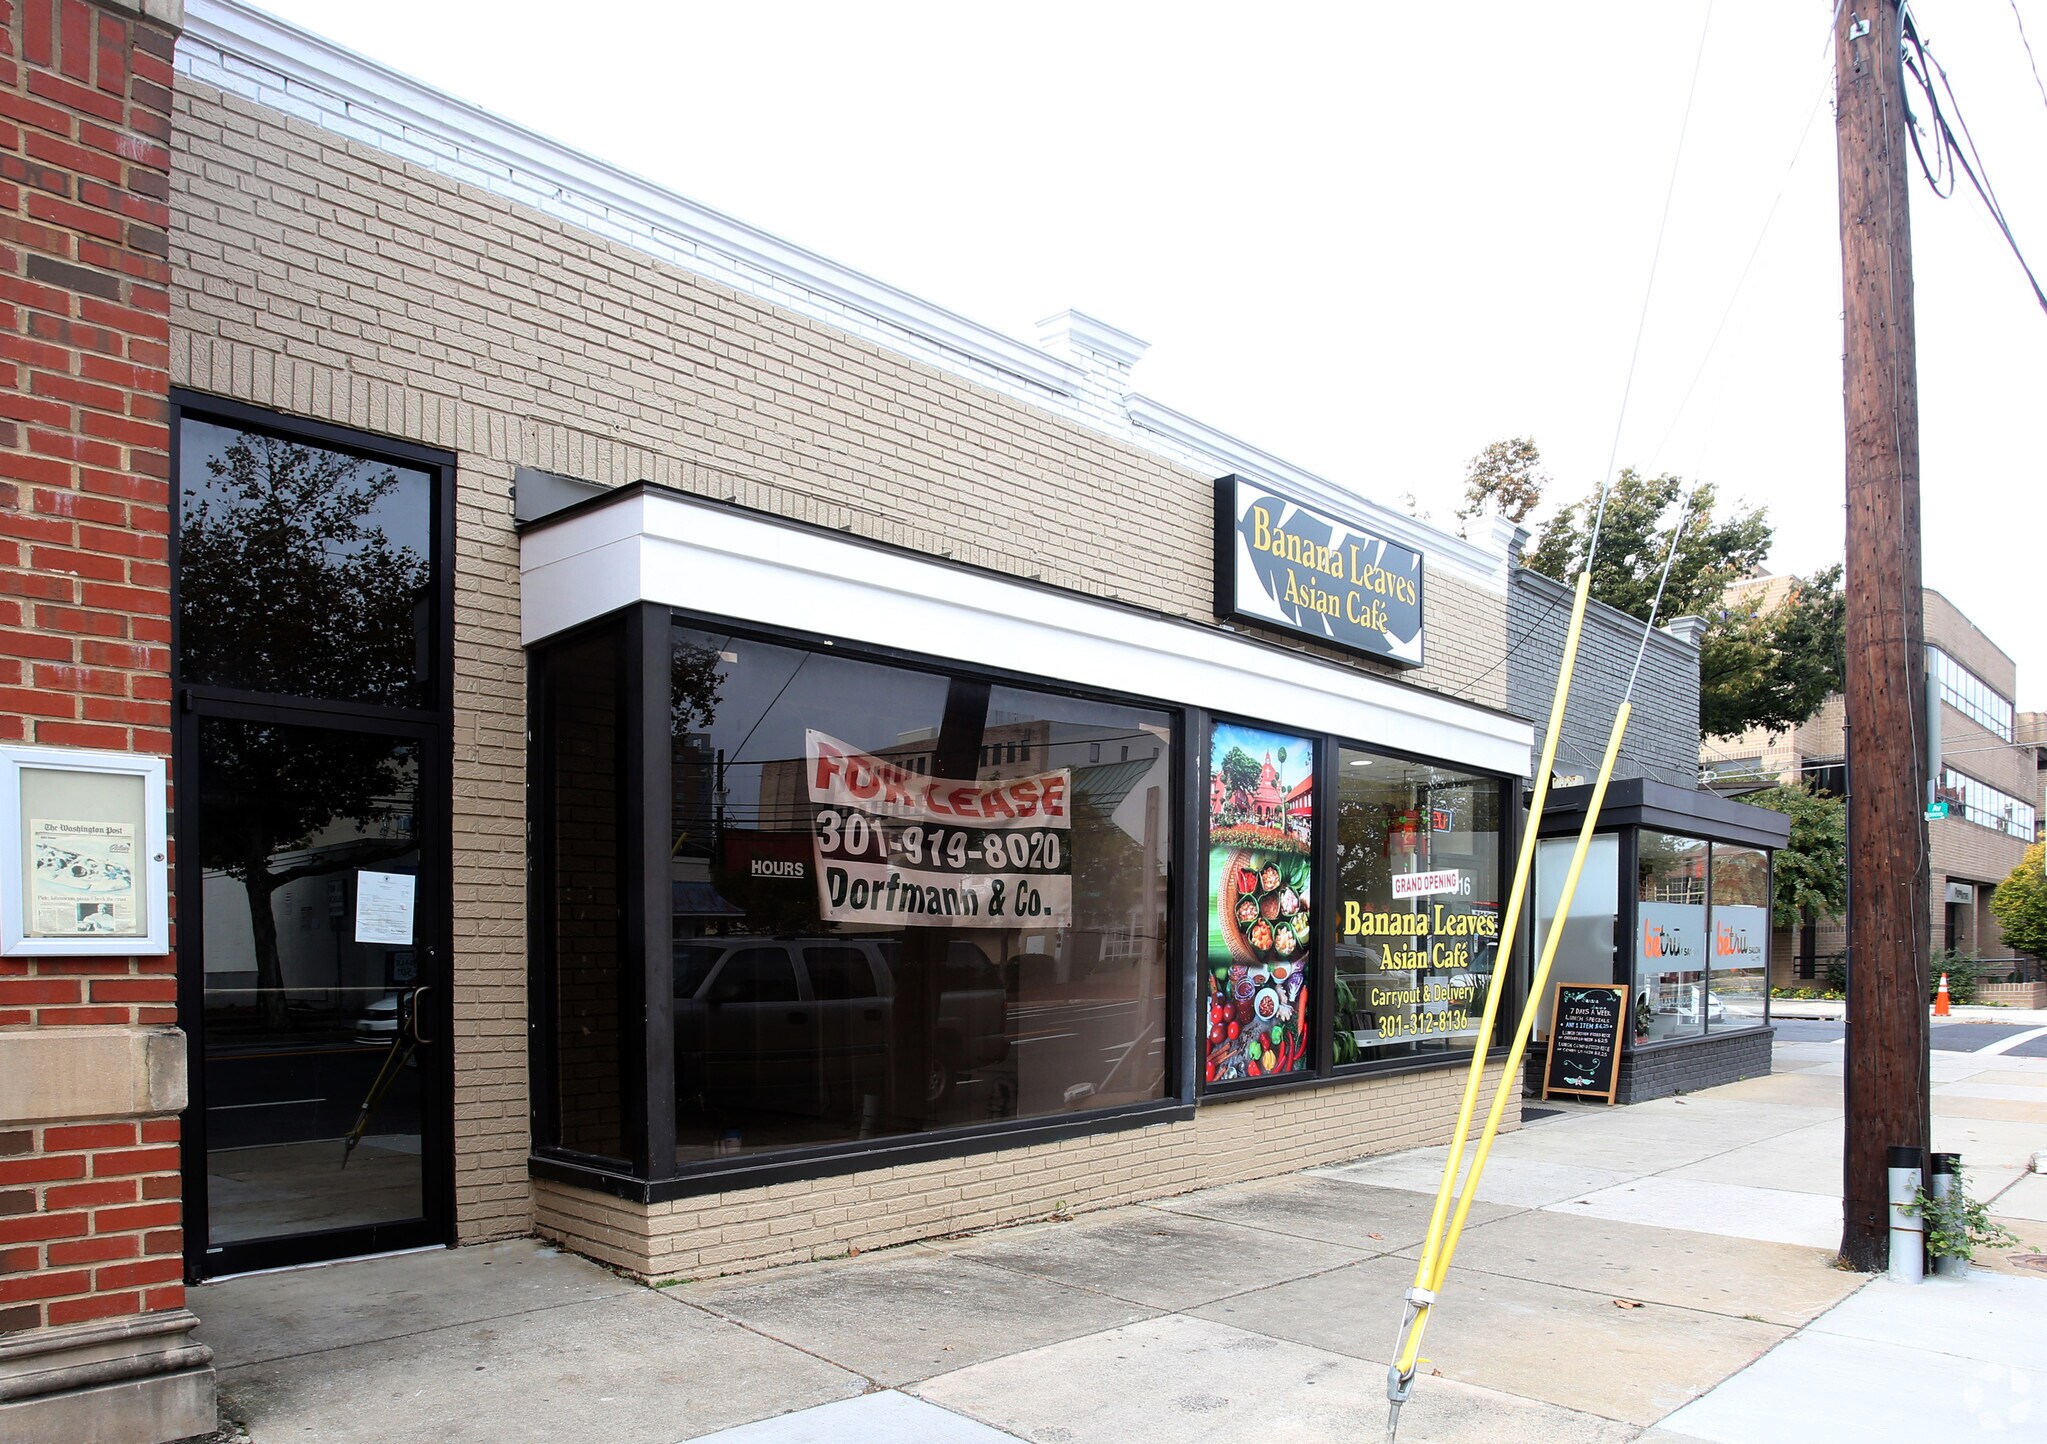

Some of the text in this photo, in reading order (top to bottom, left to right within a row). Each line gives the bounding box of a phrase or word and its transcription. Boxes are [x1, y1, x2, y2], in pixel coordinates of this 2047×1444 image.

[1253, 505, 1416, 606] Banana Leaves
[1284, 567, 1388, 634] Asian Café
[815, 741, 1065, 818] FOR LEASE
[44, 823, 123, 835] The Washington Post
[815, 810, 1060, 870] 301-919-8020
[751, 859, 804, 877] HOURS
[1395, 873, 1457, 893] GRAND OPENING
[826, 866, 1052, 917] Dorfmann & Co.
[1344, 900, 1496, 936] Banana Leaves
[1380, 942, 1468, 971] Asian Café
[1371, 983, 1475, 1009] Carryout & Delivery
[1378, 1008, 1468, 1039] 301-312-8136
